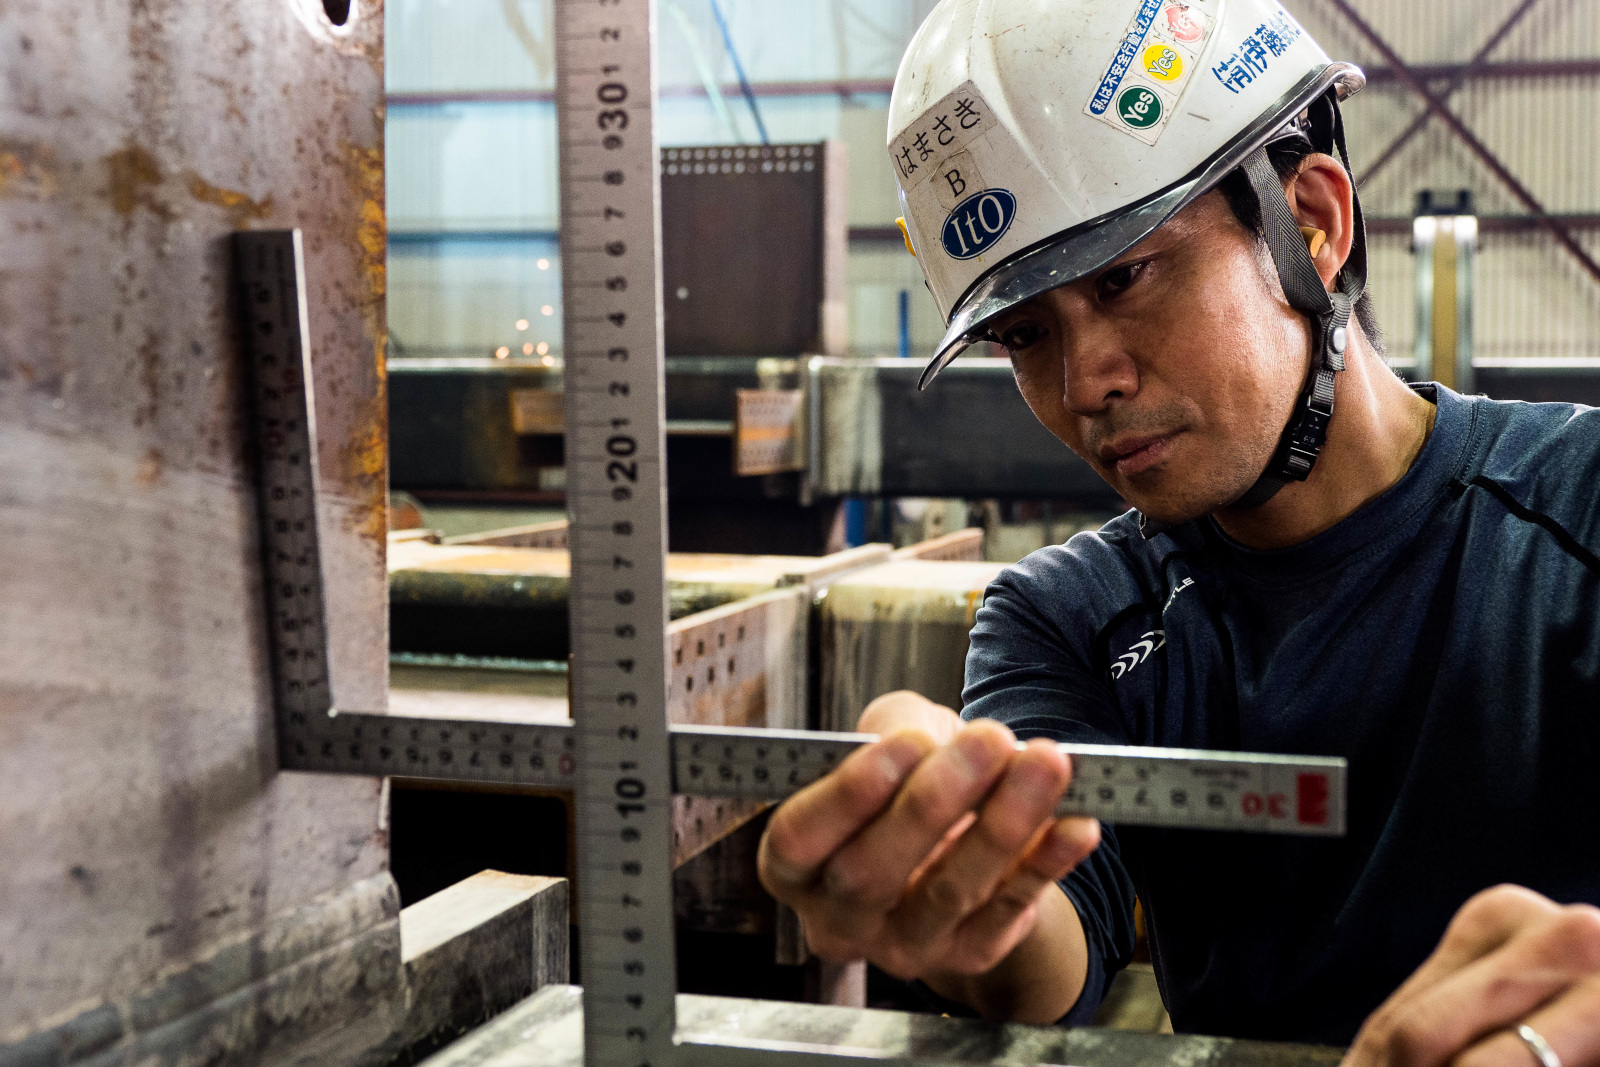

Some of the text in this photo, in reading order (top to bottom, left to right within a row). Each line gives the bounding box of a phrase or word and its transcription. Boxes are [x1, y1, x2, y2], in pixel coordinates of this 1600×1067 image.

[599, 27, 621, 42] 2
[1148, 48, 1178, 77] Yes
[601, 65, 620, 76] 1
[597, 82, 629, 130] 30
[1123, 91, 1154, 121] Yes
[602, 135, 624, 150] 9
[895, 98, 981, 179] はまさき
[602, 170, 625, 186] 8
[944, 169, 966, 197] B
[603, 206, 624, 221] 7
[604, 241, 626, 257] 6
[605, 276, 627, 291] 5
[606, 312, 627, 327] 4
[607, 347, 629, 362] 3
[607, 381, 631, 396] 2
[609, 417, 629, 429] 1
[605, 434, 638, 482] 20
[610, 486, 632, 502] 9
[611, 521, 633, 536] 8
[612, 555, 633, 570] 7
[613, 589, 635, 605] 6
[614, 623, 636, 638] 5
[615, 658, 636, 673] 4
[615, 692, 638, 707] 3
[616, 726, 639, 741] 2
[619, 761, 637, 771] 1
[615, 778, 647, 819] 10
[619, 827, 641, 843] 9
[620, 861, 642, 876] 8
[621, 894, 641, 908] 7
[622, 927, 644, 943] 6
[623, 961, 645, 976] 5
[624, 994, 644, 1010] 4
[625, 1027, 648, 1043] 3
